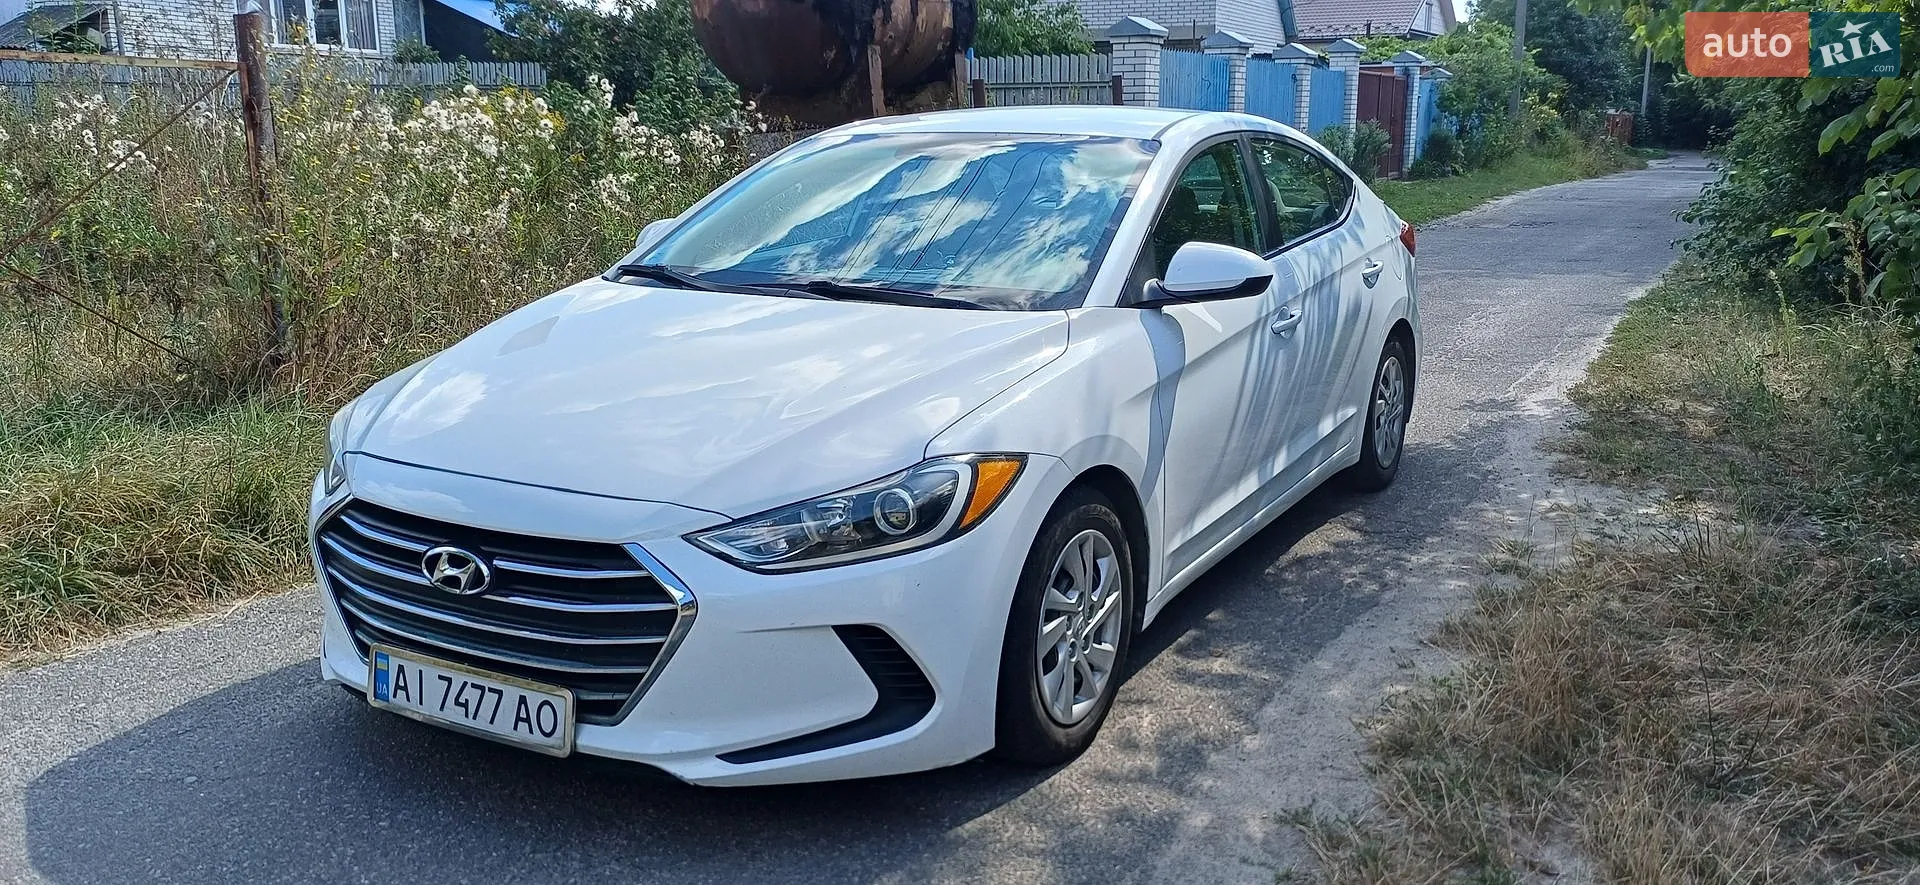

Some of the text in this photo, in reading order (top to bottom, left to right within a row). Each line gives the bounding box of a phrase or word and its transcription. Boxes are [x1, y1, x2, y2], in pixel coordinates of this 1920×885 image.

[376, 681, 388, 697] UA
[392, 663, 558, 738] AI 7477 AO
